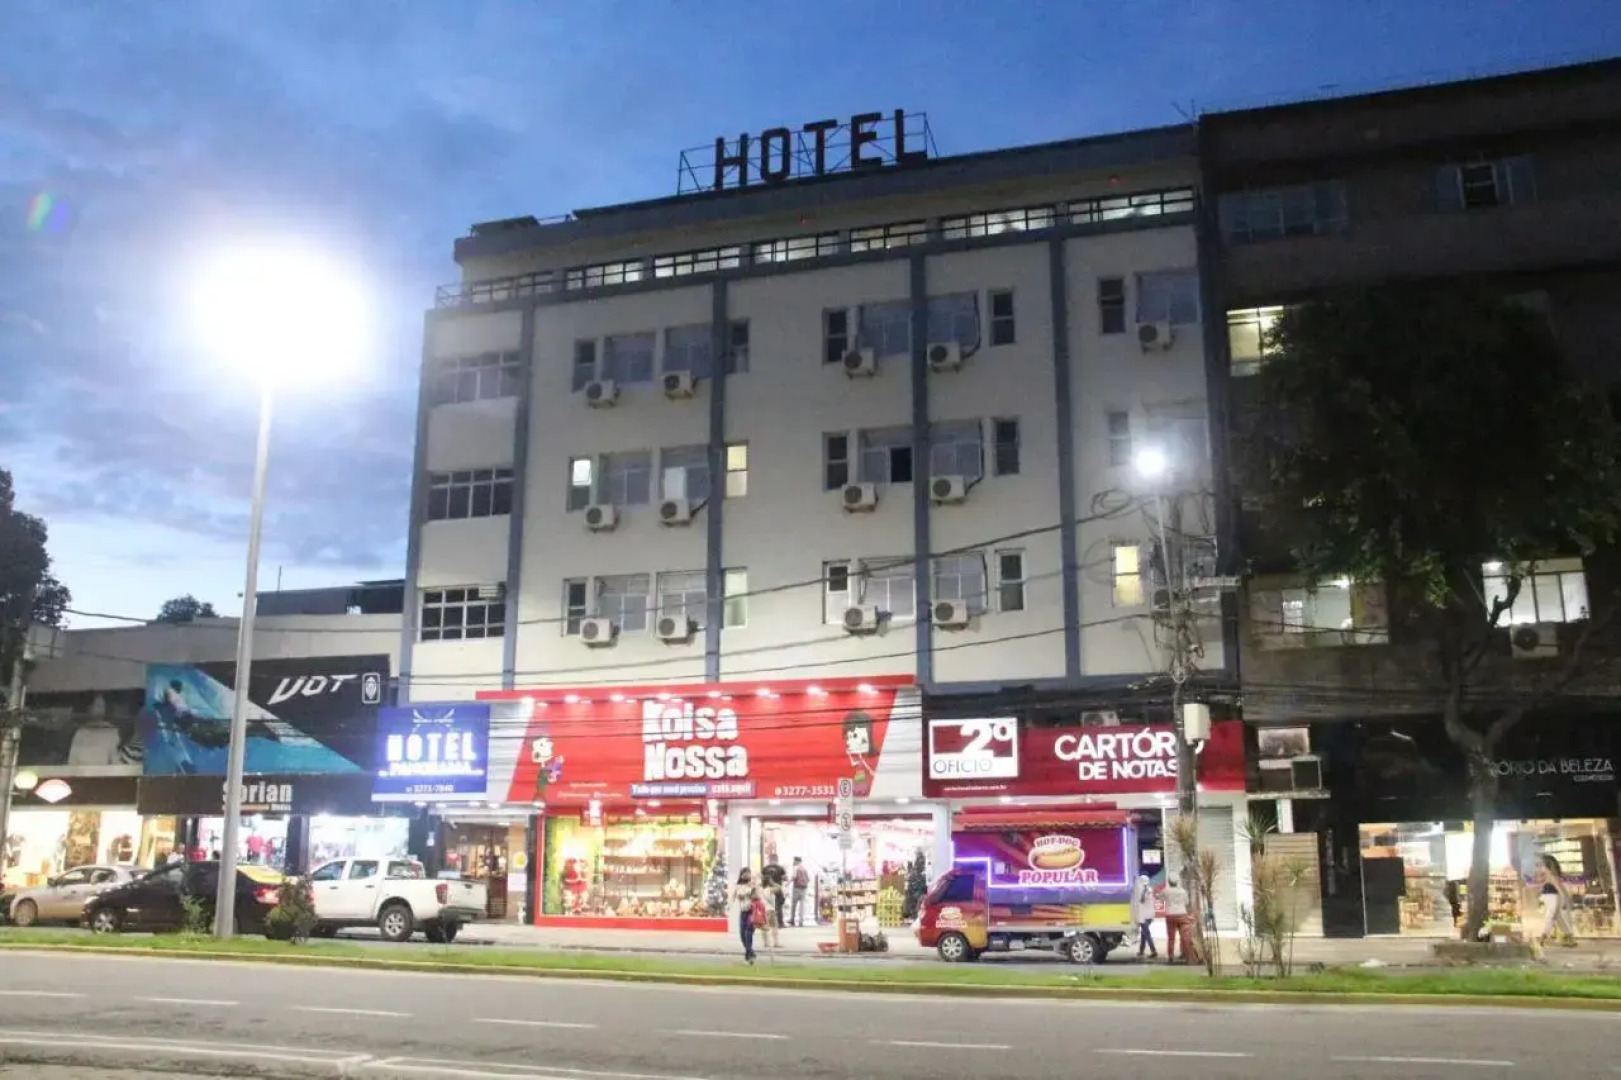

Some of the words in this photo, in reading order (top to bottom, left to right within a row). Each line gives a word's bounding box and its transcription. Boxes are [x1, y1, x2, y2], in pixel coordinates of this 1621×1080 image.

[715, 109, 927, 190] HOTEL
[643, 700, 738, 742] Koisa
[387, 732, 477, 761] HOTEL
[1054, 727, 1204, 761] CARTÓR
[644, 743, 748, 780] Nossa
[1079, 761, 1107, 780] DE
[1112, 758, 1178, 779] NOTAS
[1538, 760, 1556, 775] DA
[1560, 758, 1613, 773] BELEZA
[1020, 869, 1098, 885] POPULAR
